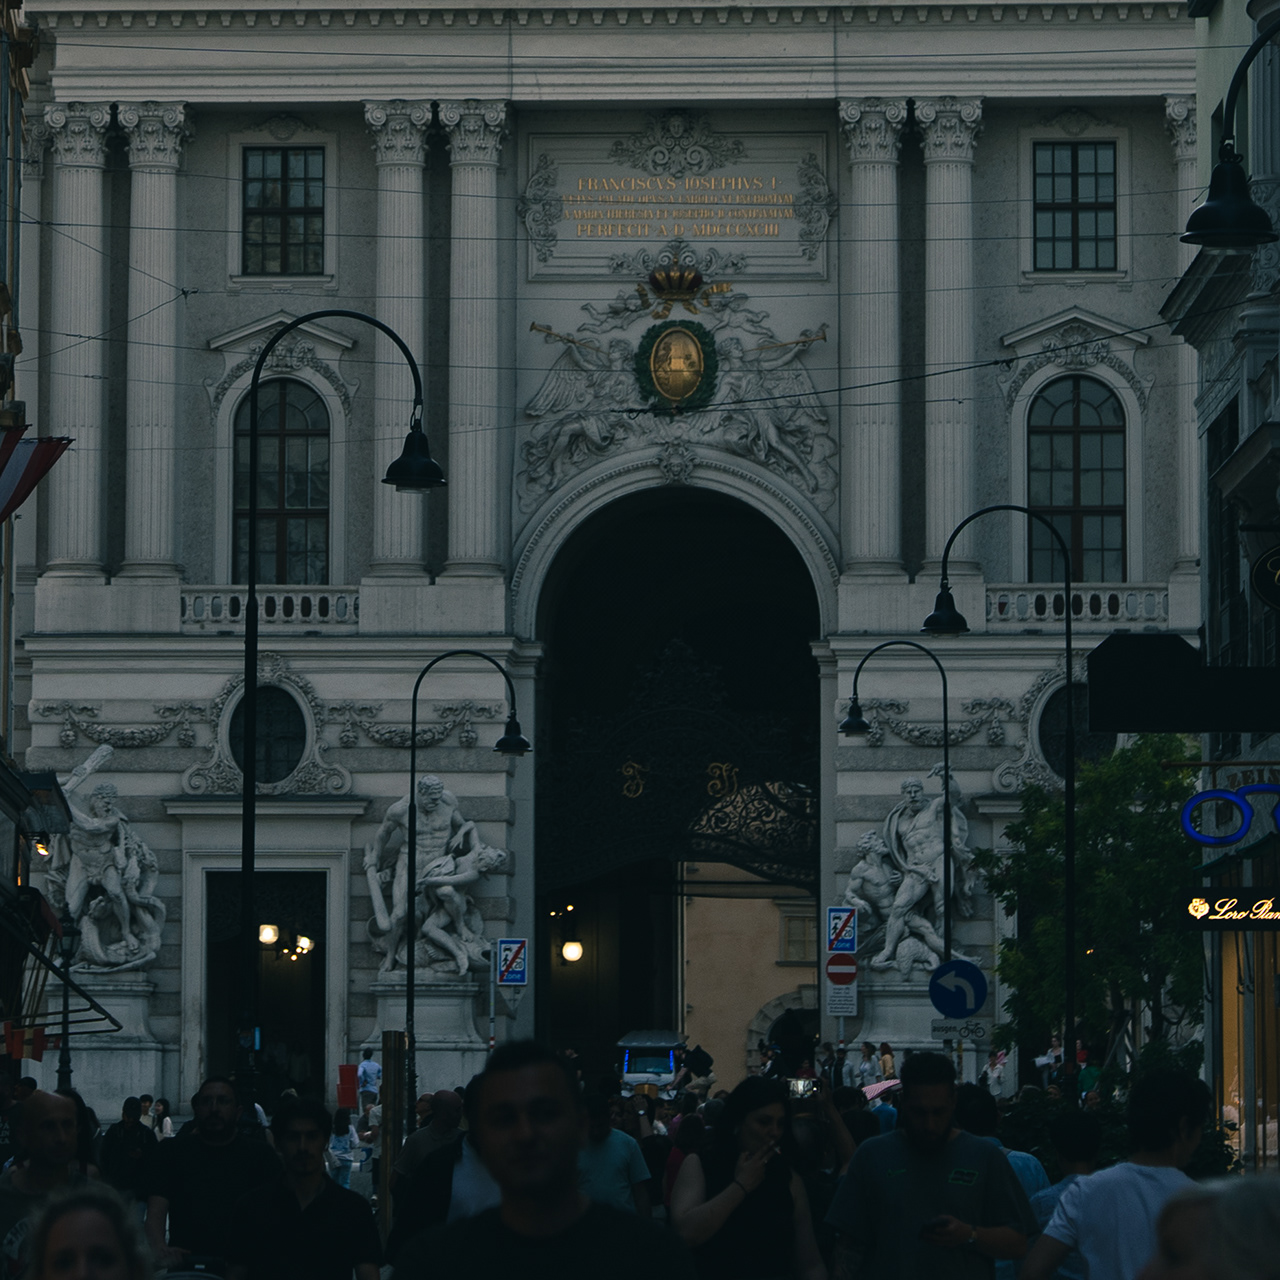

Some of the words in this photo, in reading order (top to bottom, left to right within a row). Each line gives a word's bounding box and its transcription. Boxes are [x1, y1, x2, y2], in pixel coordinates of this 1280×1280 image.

[578, 177, 677, 191] FRANCISCVS
[685, 176, 763, 190] IOSEPHVS
[577, 223, 651, 237] PERFECIT
